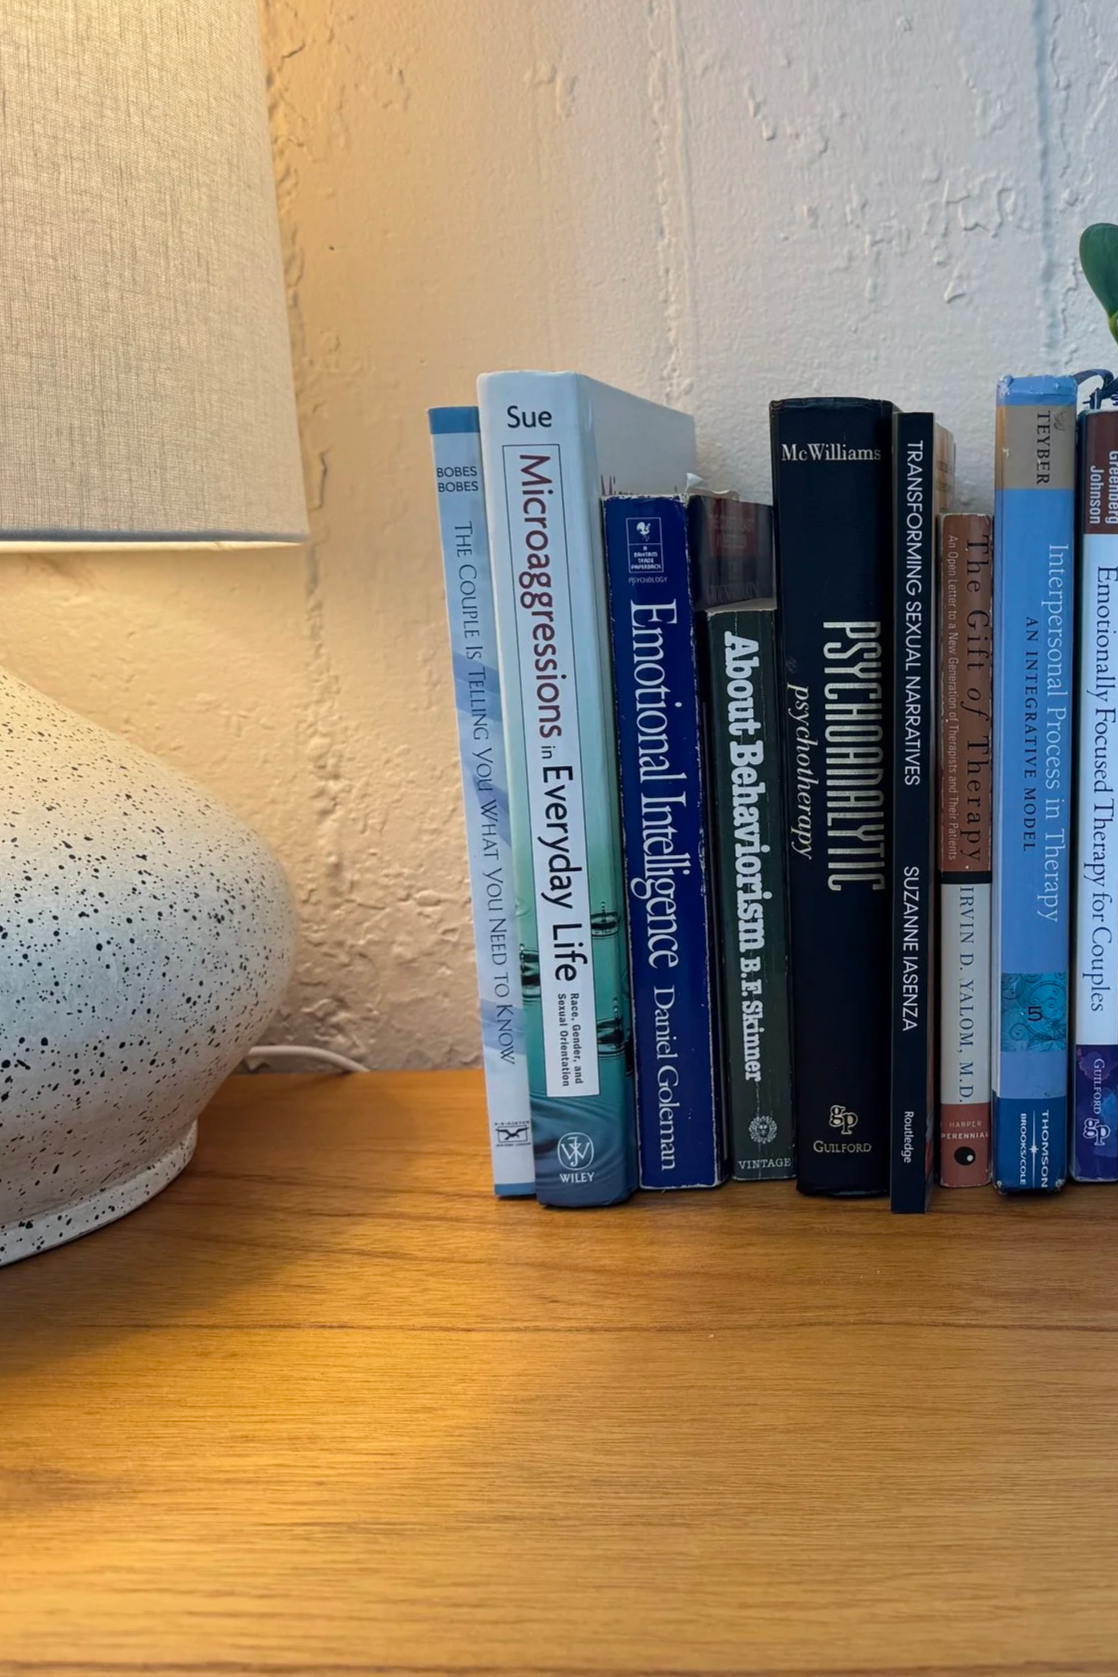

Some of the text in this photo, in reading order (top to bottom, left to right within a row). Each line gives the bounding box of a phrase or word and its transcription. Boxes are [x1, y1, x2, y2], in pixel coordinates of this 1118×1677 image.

[506, 404, 553, 429] Sue
[436, 466, 478, 478] BOBES
[782, 443, 882, 462] McWilliams
[1036, 410, 1050, 484] TEYBER
[438, 481, 479, 493] BOBES
[1090, 466, 1104, 524] Johnson
[454, 521, 473, 558] THE
[946, 552, 958, 576] Open
[948, 534, 958, 548] An
[458, 564, 480, 638] COUPLE
[628, 576, 668, 584] PSYCHOLOGY
[948, 579, 958, 607] Letter
[904, 440, 924, 786] TRANSFORMING SEXUAL NARRATIVES
[948, 610, 957, 621] to
[948, 632, 958, 654] New
[468, 666, 489, 740] TELLING
[724, 631, 762, 736] About
[948, 658, 958, 709] Generation
[960, 534, 990, 862] The Gift of Therapy
[519, 454, 588, 982] Microaggressions in Everyday Life
[949, 712, 958, 722] of
[1023, 616, 1038, 852] AN INTEGRATIVE MODEL
[1037, 544, 1069, 922] Interpersonal Process in Therapy
[472, 748, 494, 791] YOU
[786, 682, 819, 860] psychotherapy
[823, 622, 885, 891] PSYCHOANALYTIC
[948, 724, 958, 773] Therapists
[630, 598, 692, 969] Emotional Intelligence
[948, 776, 958, 793] and
[948, 794, 958, 820] Their
[1082, 566, 1118, 1012] Emotionally Focused Therapy for Couples
[480, 799, 500, 861] WHAT
[730, 740, 772, 953] Behaviorism
[948, 822, 958, 860] Patients
[483, 868, 504, 912] YOU
[488, 918, 508, 966] NEED
[902, 866, 920, 1032] SUZANNE IASENZA
[494, 972, 510, 998] TO
[958, 886, 974, 1102] IRVIN D. YALOM, M.D.
[496, 1004, 516, 1065] KNOW
[570, 993, 584, 1084] Race, Gender, and
[1028, 1006, 1043, 1022] 5
[558, 993, 570, 1087] Sexual Orientation
[742, 1000, 764, 1082] Skinner
[654, 985, 680, 1172] Daniel Goleman
[1094, 1058, 1105, 1114] GUILFORD
[813, 1140, 872, 1153] GUILFORD
[901, 1111, 914, 1164] Routledge
[941, 1132, 989, 1140] PERENNIAL
[950, 1120, 982, 1128] HARPER
[1041, 1109, 1050, 1188] THOMSON
[560, 1172, 595, 1183] WILEY
[738, 1158, 792, 1170] VINTAGE
